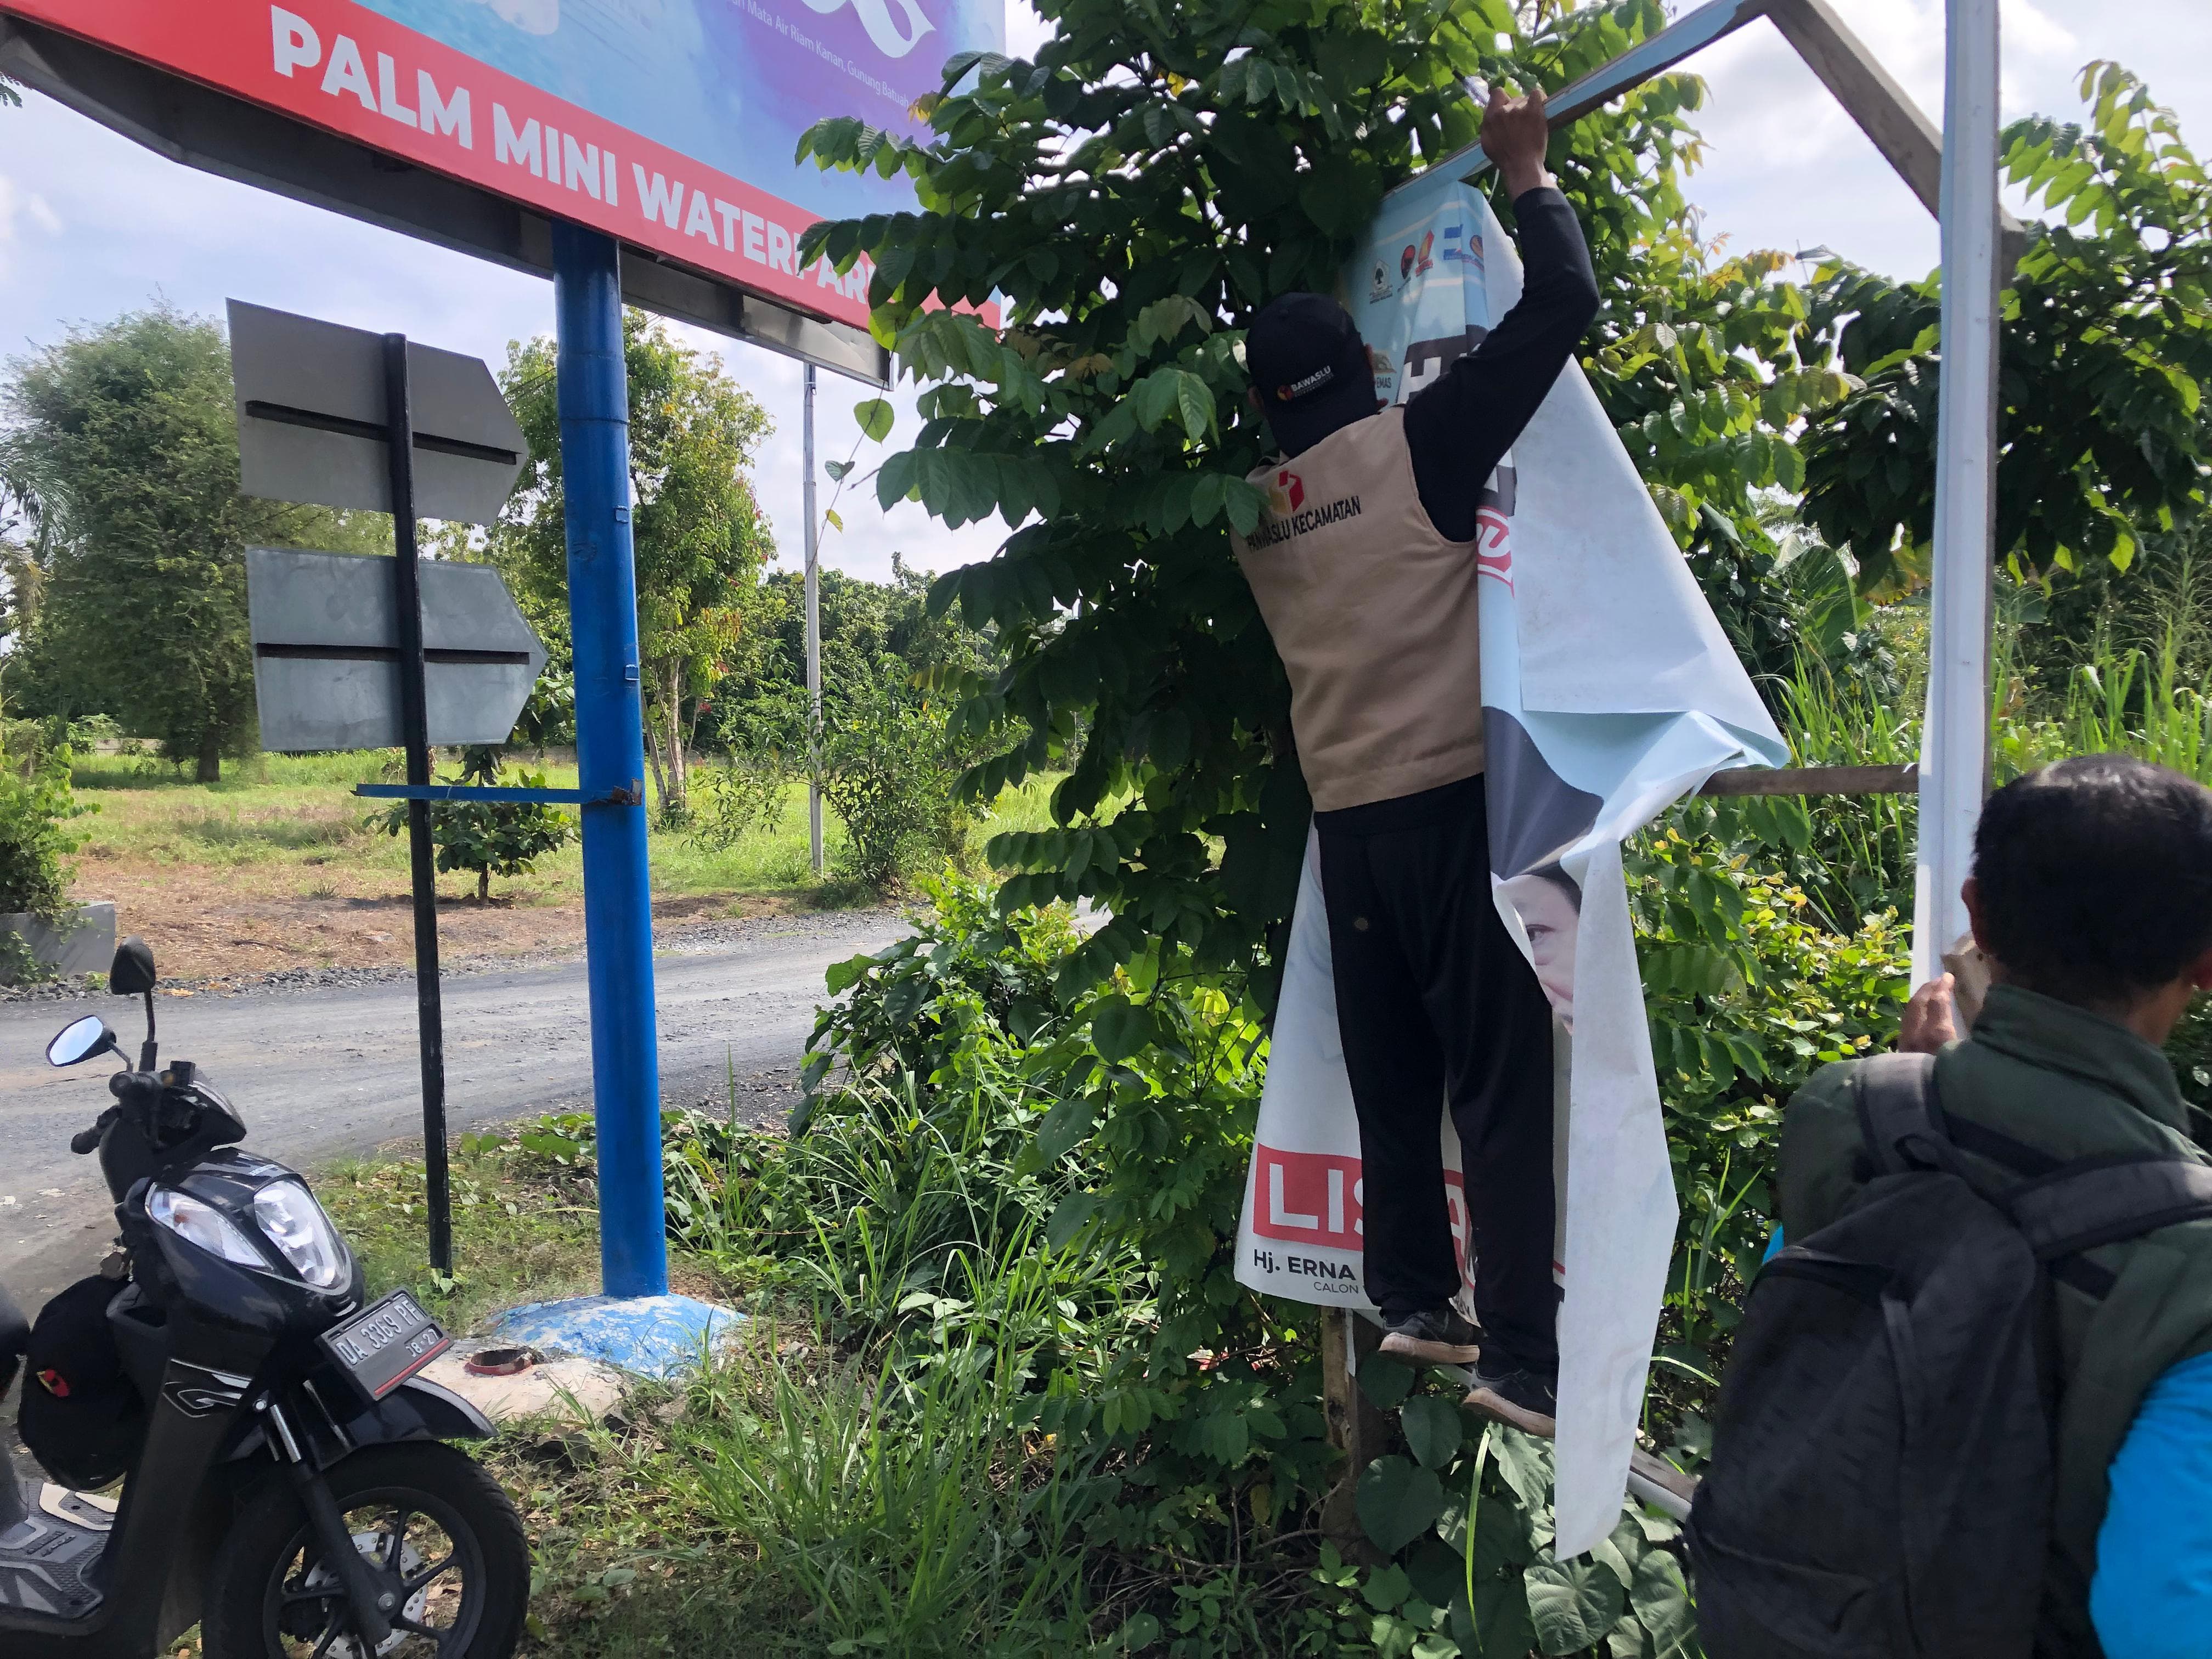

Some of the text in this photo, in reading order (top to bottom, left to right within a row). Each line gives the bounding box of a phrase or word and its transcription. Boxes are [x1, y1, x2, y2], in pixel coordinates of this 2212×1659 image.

[747, 0, 772, 26] Mata
[775, 15, 788, 35] Air
[791, 24, 814, 52] Riam
[815, 40, 846, 72] Kanan,
[848, 60, 881, 95] Gunung
[271, 4, 877, 305] PALM MINI WATERAR
[1291, 365, 1331, 392] BAWASLU
[1291, 495, 1361, 537] KECAMATAN
[1254, 1249, 1356, 1280] Hj. ERNA
[1313, 1282, 1359, 1294] CALON
[336, 1337, 368, 1365] DA
[360, 1313, 402, 1349] 3369
